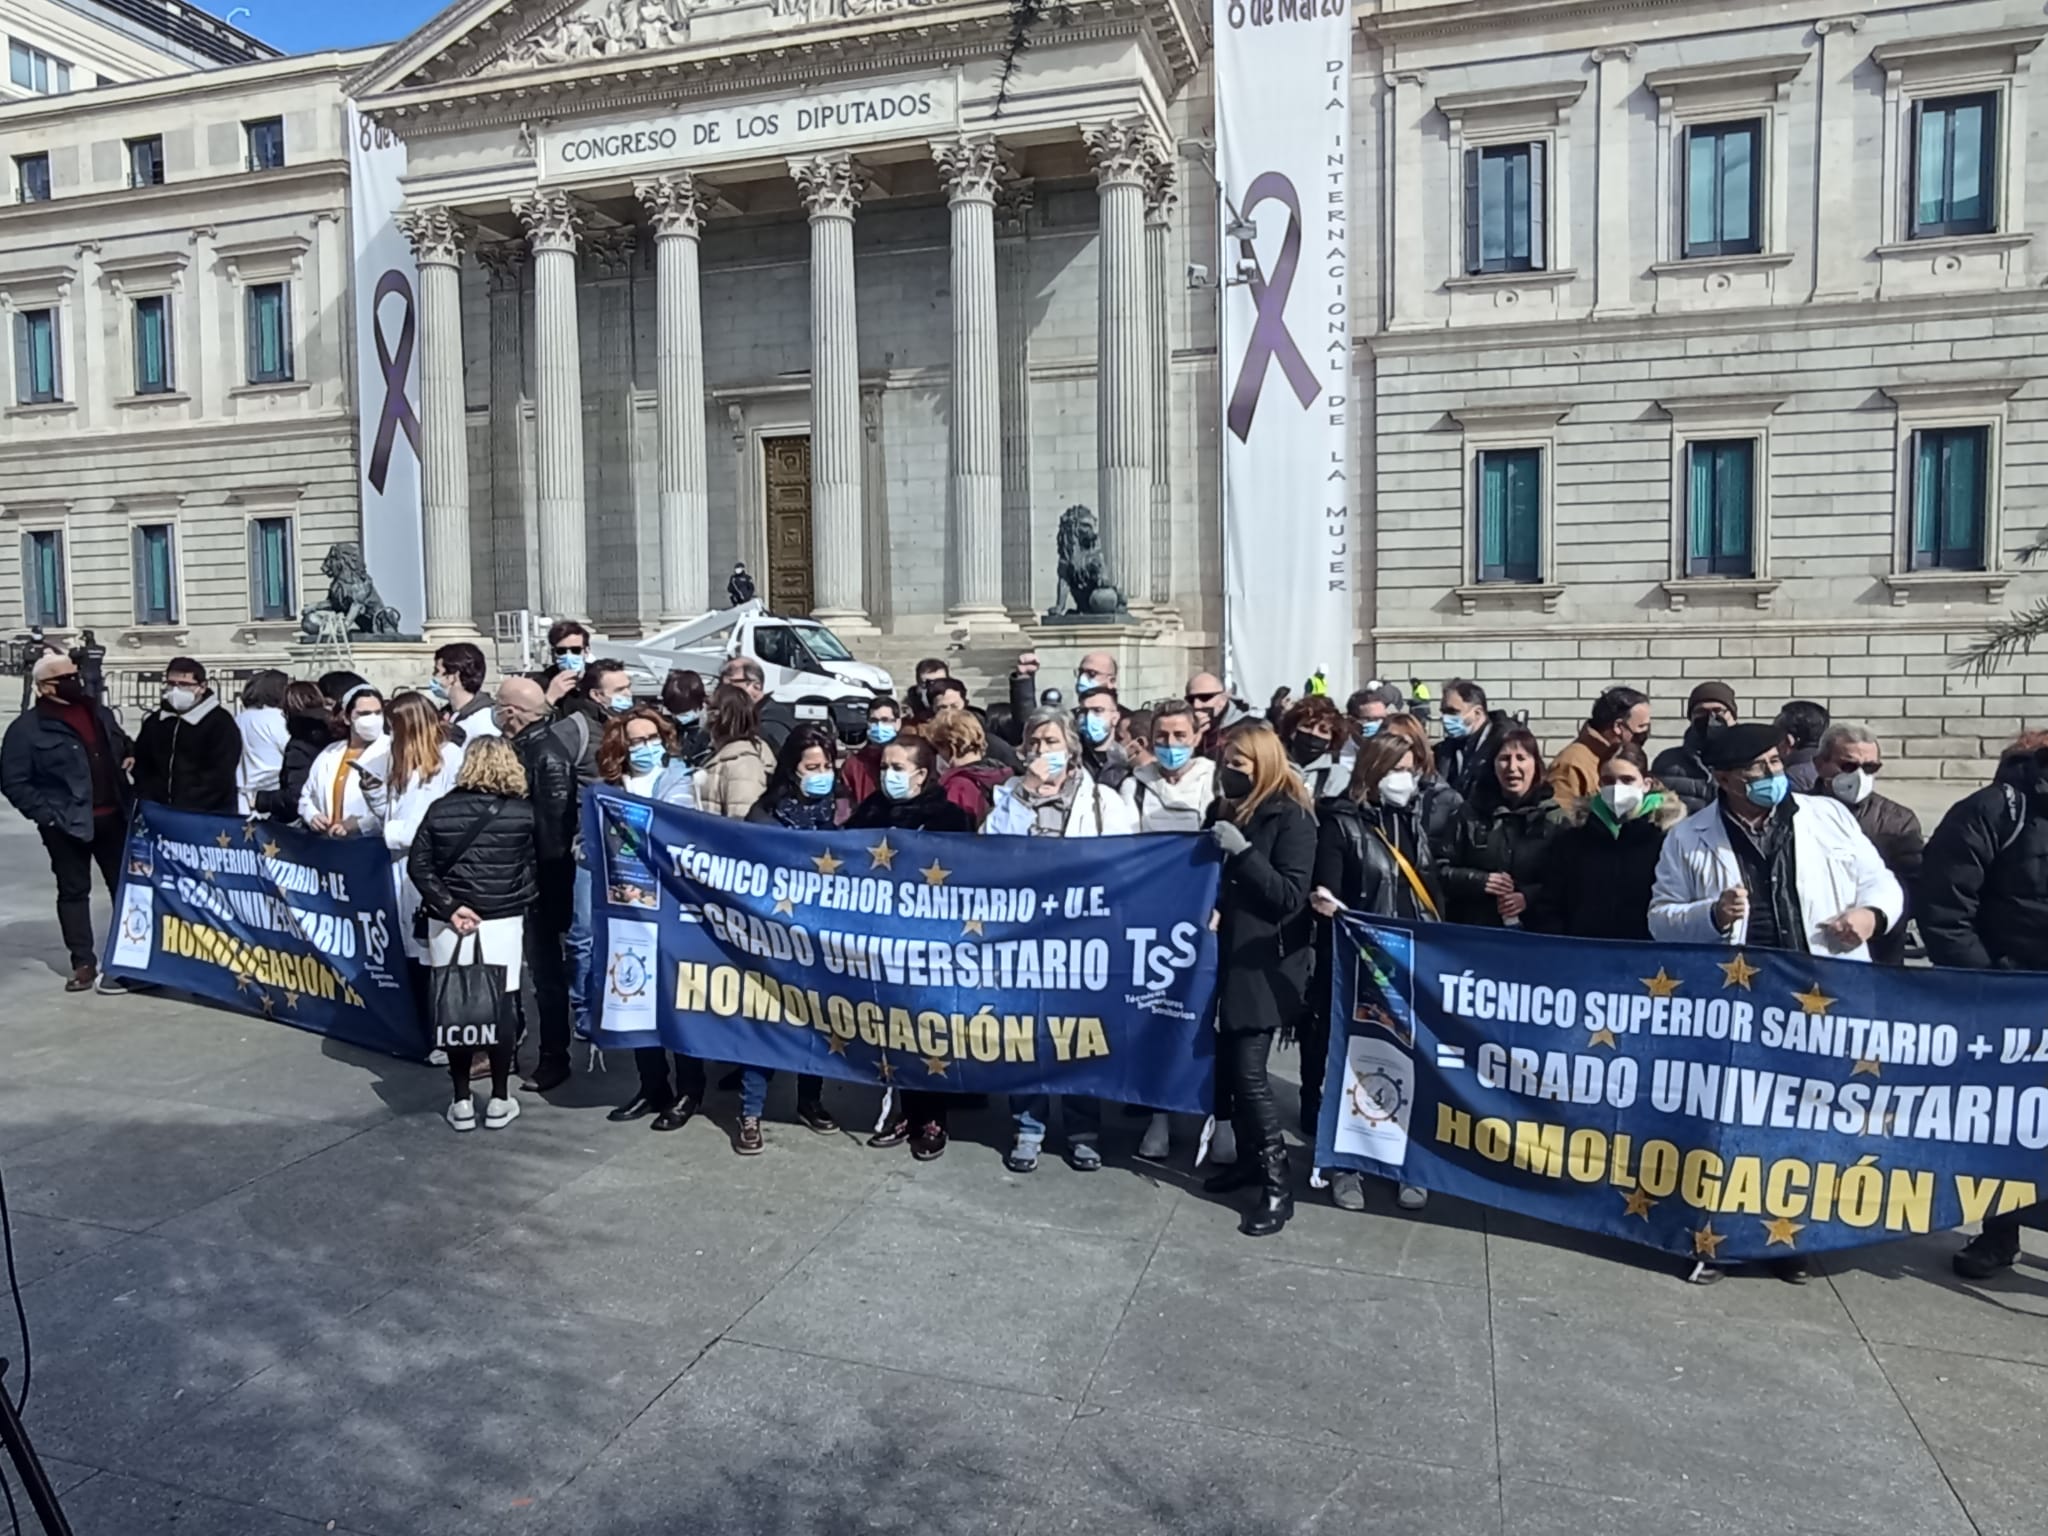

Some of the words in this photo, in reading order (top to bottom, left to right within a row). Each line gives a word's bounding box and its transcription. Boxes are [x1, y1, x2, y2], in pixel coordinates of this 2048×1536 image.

[561, 127, 678, 163] CONGRESO
[693, 121, 721, 145] DE
[737, 114, 780, 140] LOS
[797, 92, 932, 132] DIPUTADOS
[1326, 134, 1346, 370] INTERNACIONAL
[1328, 395, 1346, 426] DE
[1327, 451, 1346, 481] LA
[1326, 505, 1347, 592] MUJER
[200, 845, 258, 876] SUPERIOR
[666, 843, 769, 897] TÉCNICO
[772, 866, 894, 915] SUPERIOR
[898, 881, 1036, 923] SANITARIO
[1041, 894, 1059, 916] +
[1064, 885, 1111, 919] U.E.
[702, 902, 815, 967] GRADO
[818, 929, 1109, 991] UNIVERSITARIO
[675, 960, 1036, 1063] HOMOLOGACIÓN
[1046, 1016, 1111, 1062] YA
[1438, 969, 1577, 1029] TÉCNICO
[1583, 991, 1754, 1044] SUPERIOR
[1760, 1005, 1959, 1067] SANITARIO
[1967, 1034, 1993, 1060] +
[1477, 1042, 1639, 1109] GRADO
[1650, 1058, 2048, 1150] UNIVERSITARIO
[1435, 1102, 1935, 1235] HOMOLOGACIÓN
[1954, 1174, 2037, 1225] YA
